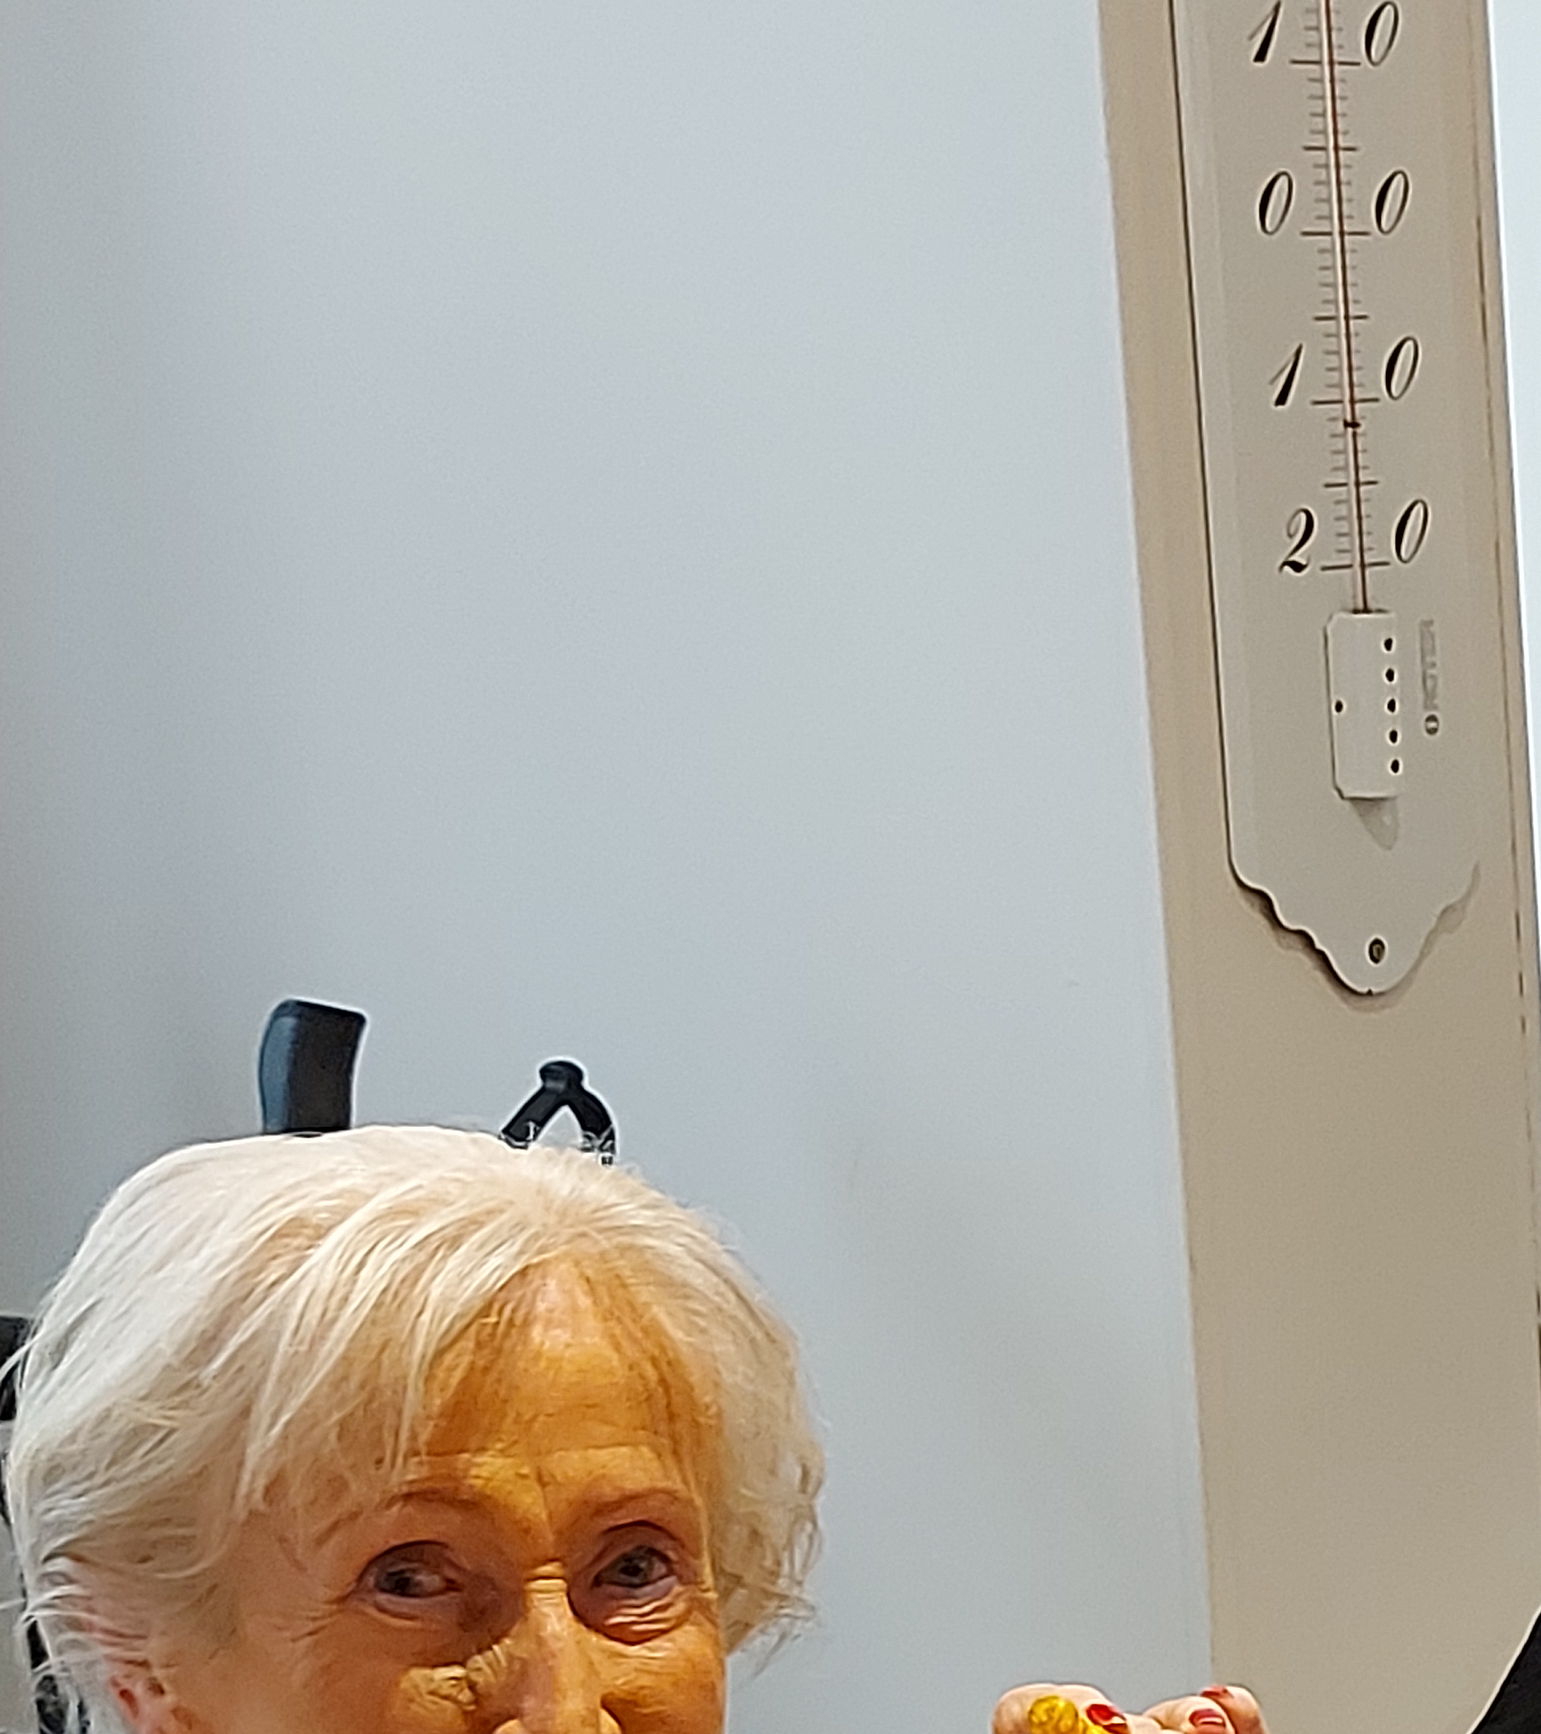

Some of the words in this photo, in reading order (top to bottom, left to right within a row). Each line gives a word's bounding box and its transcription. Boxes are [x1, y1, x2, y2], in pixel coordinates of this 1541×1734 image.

[1364, 1, 1399, 67] 0
[1258, 170, 1293, 236] 0
[1375, 169, 1409, 235] 0
[1270, 343, 1303, 407] 1
[1385, 336, 1419, 401] 0
[1279, 507, 1314, 574] 2
[1395, 499, 1428, 564] 0
